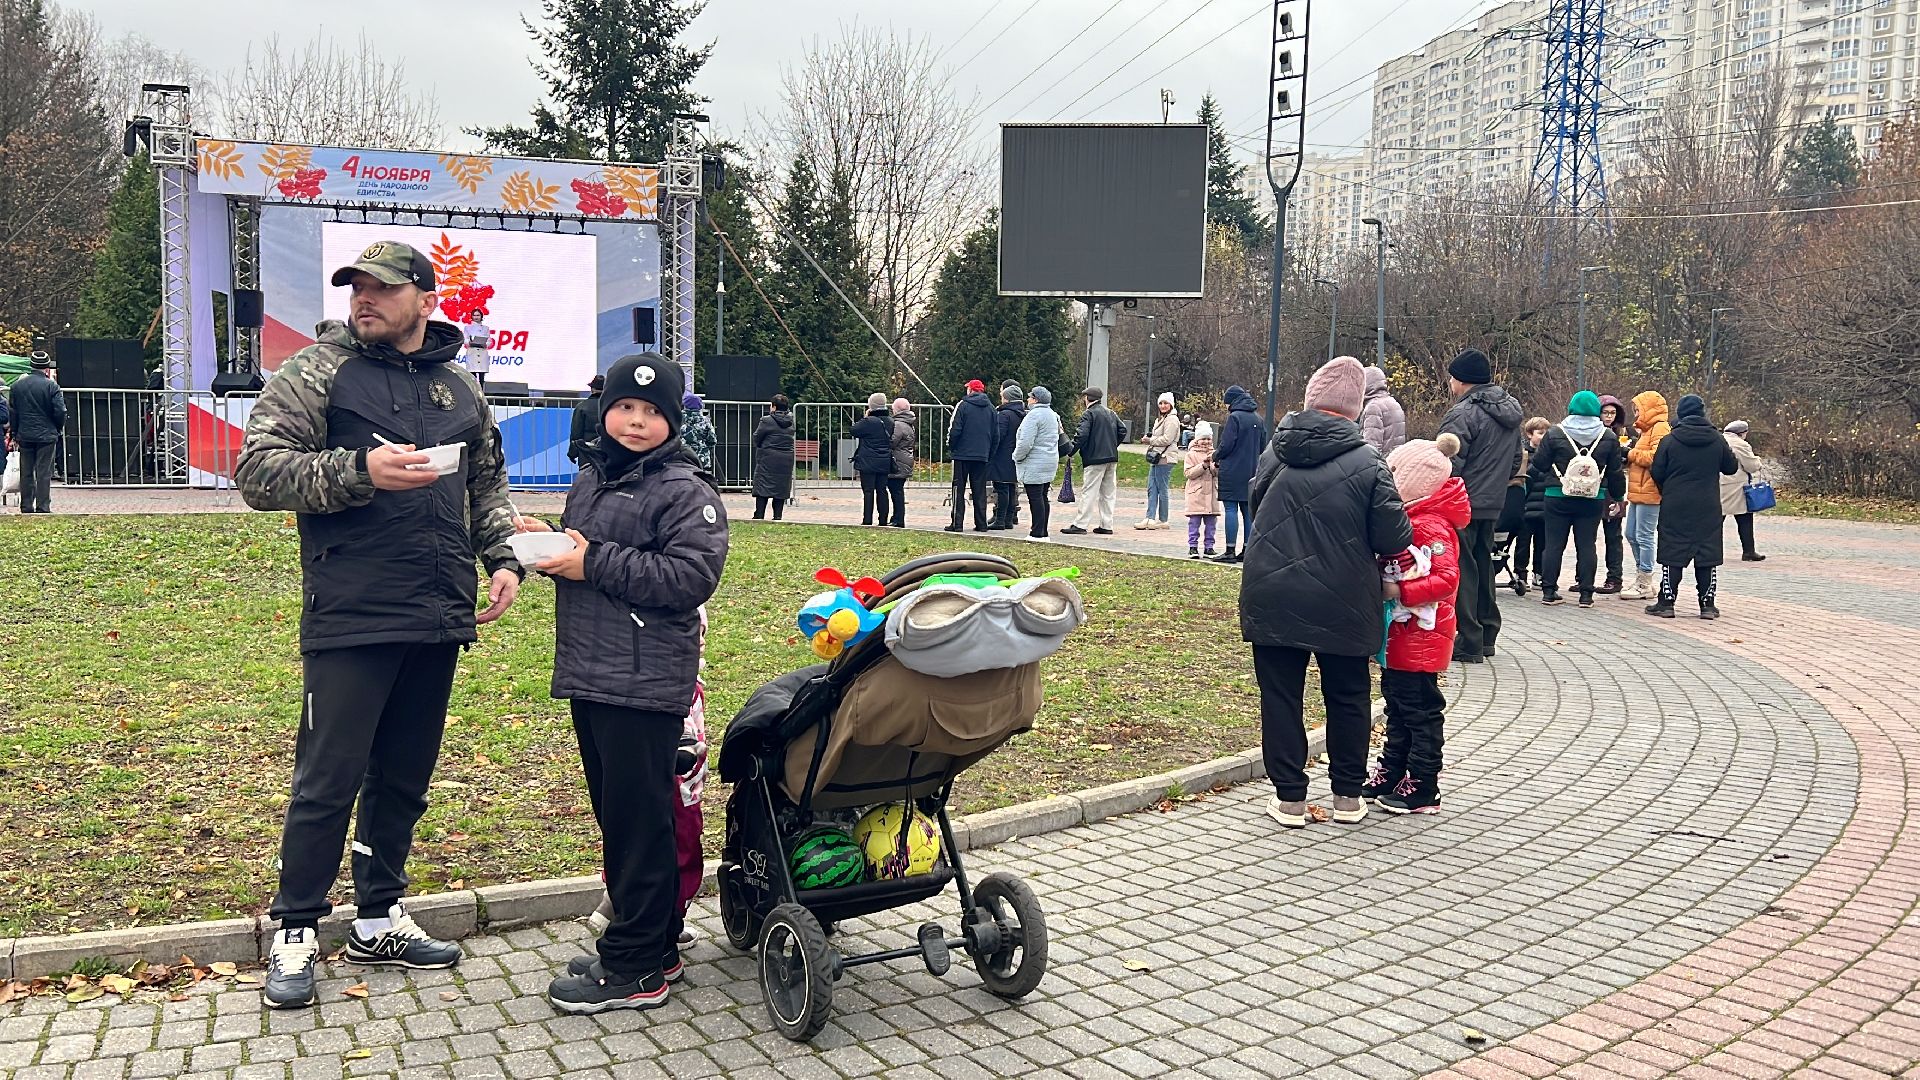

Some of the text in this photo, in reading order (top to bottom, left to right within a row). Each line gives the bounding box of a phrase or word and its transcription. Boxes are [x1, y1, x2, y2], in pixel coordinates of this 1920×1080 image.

[341, 155, 431, 182] 4 НОЯБРЯ
[356, 189, 396, 197] ЕДИНСТВА
[380, 182, 429, 191] НАРОДНОГО
[376, 937, 409, 958] N
